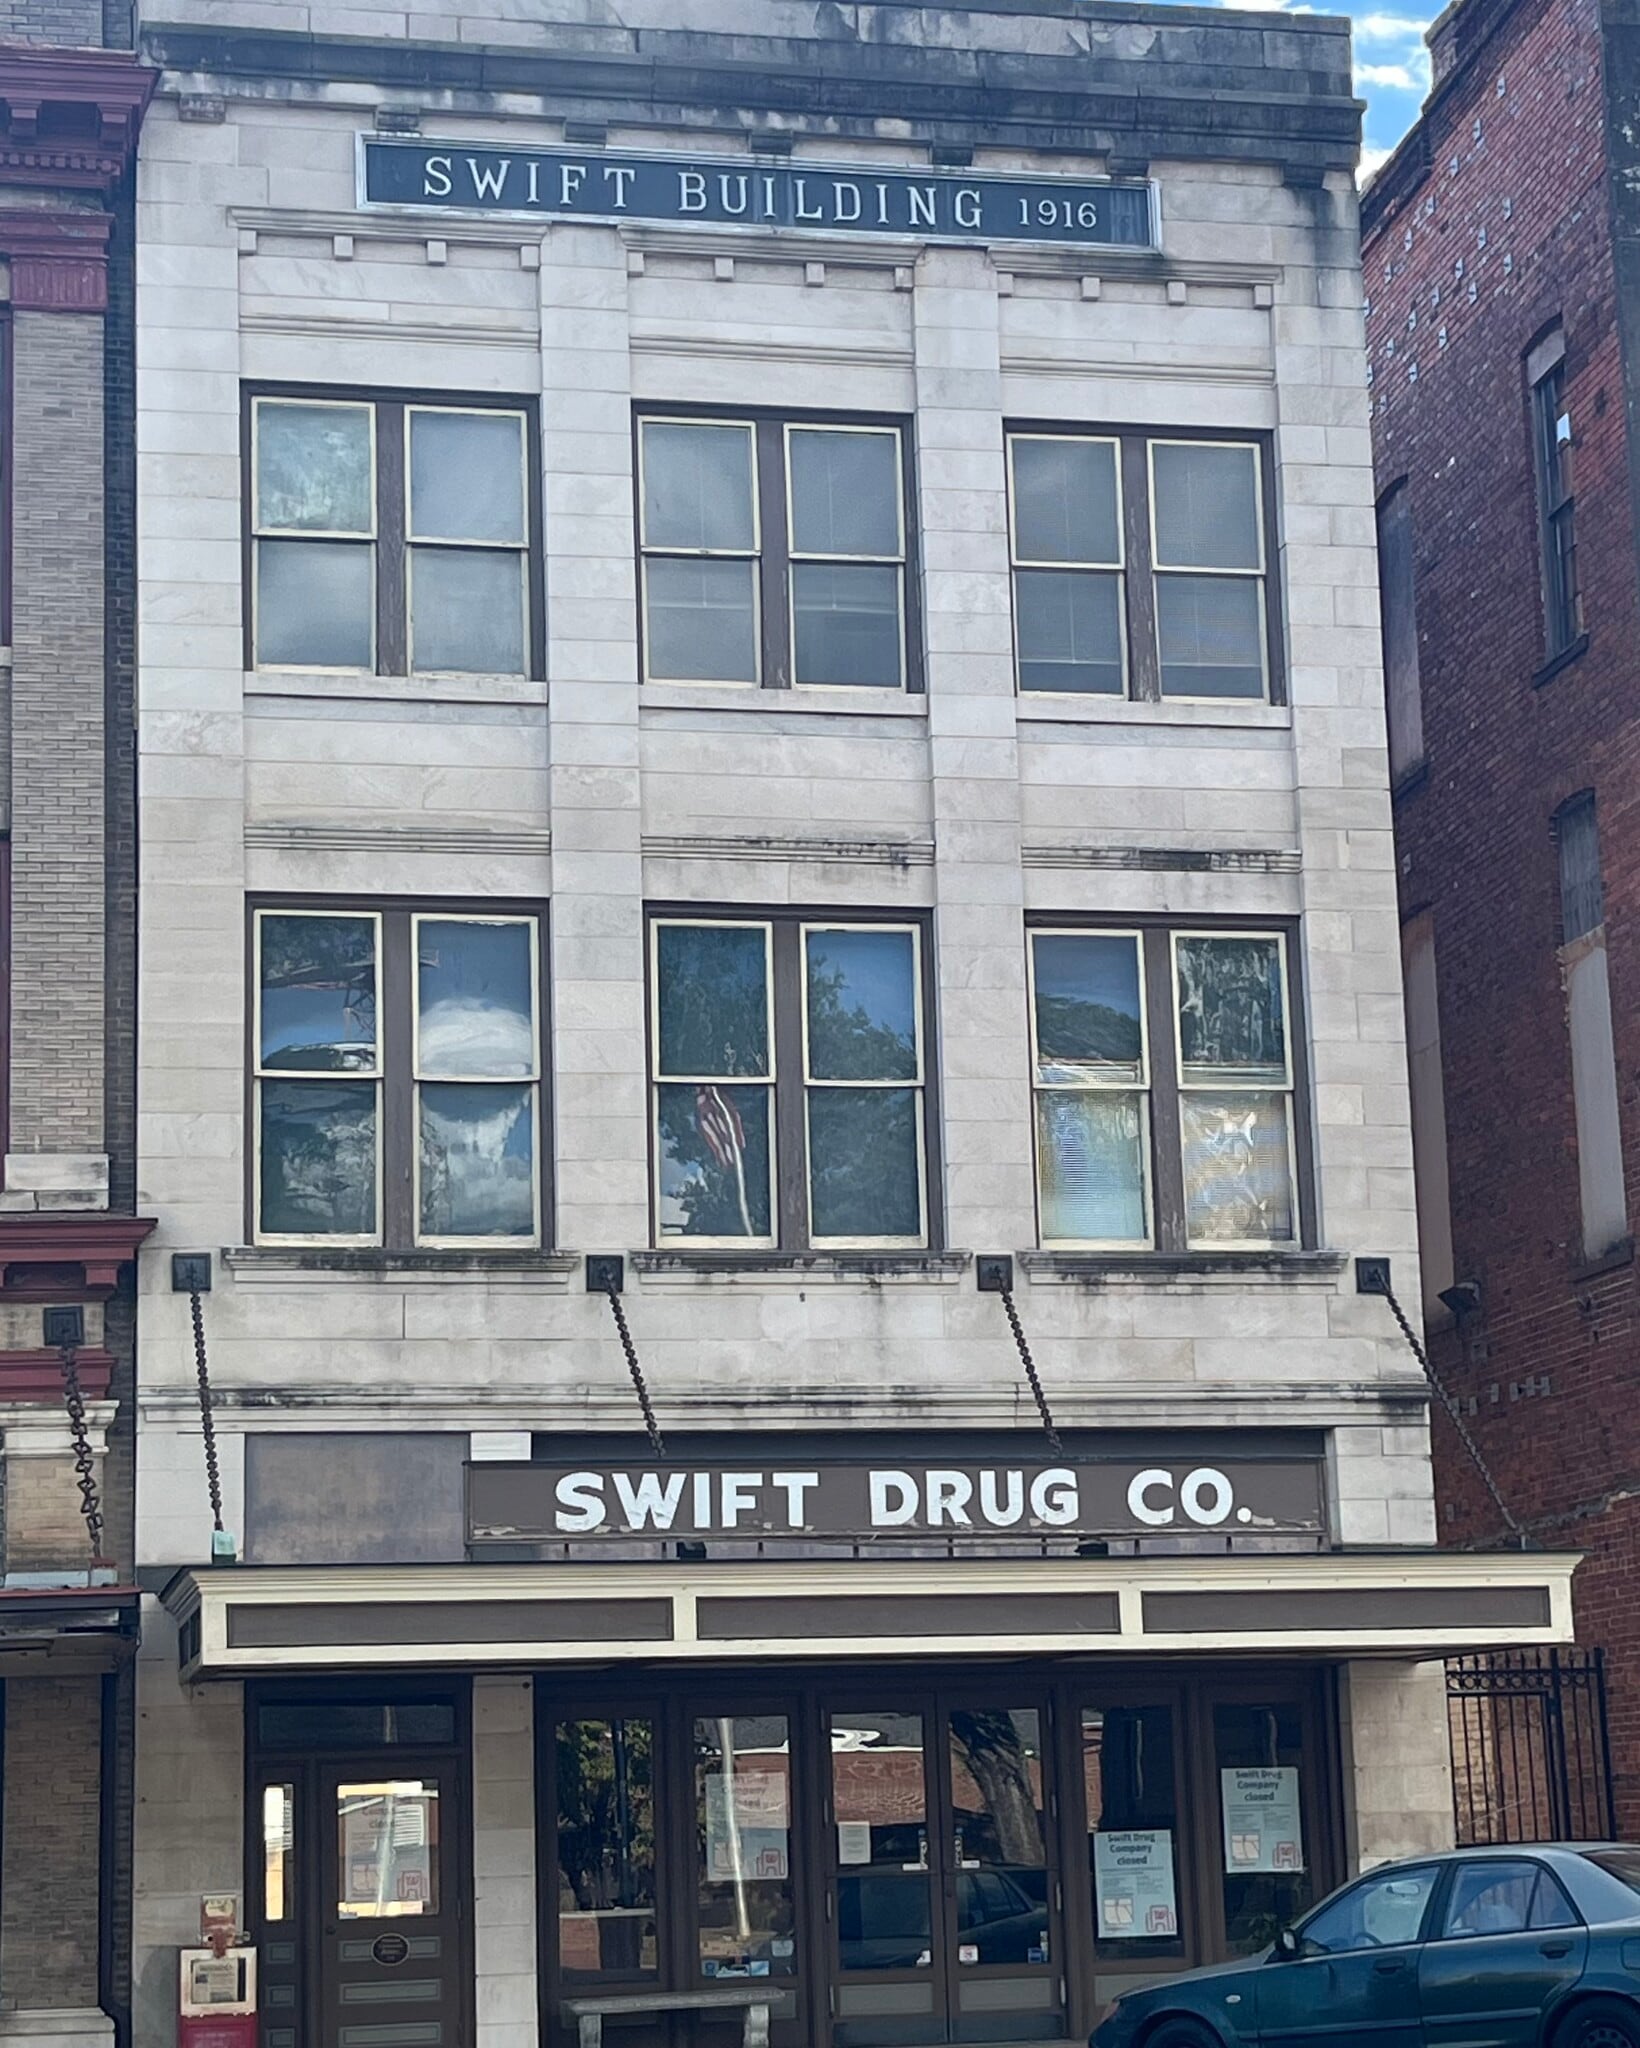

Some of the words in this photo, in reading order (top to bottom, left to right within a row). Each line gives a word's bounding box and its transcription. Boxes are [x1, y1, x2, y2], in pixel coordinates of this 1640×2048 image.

[423, 156, 636, 209] SWIFT
[678, 167, 982, 229] BUILDING
[1018, 198, 1098, 230] 1916
[555, 1471, 820, 1533] SWIFT
[869, 1468, 1079, 1527] DRUG
[1126, 1467, 1253, 1526] CO.
[1237, 1781, 1279, 1790] Company
[1244, 1792, 1275, 1801] closed
[1109, 1844, 1152, 1854] Company
[1117, 1856, 1148, 1866] closed
